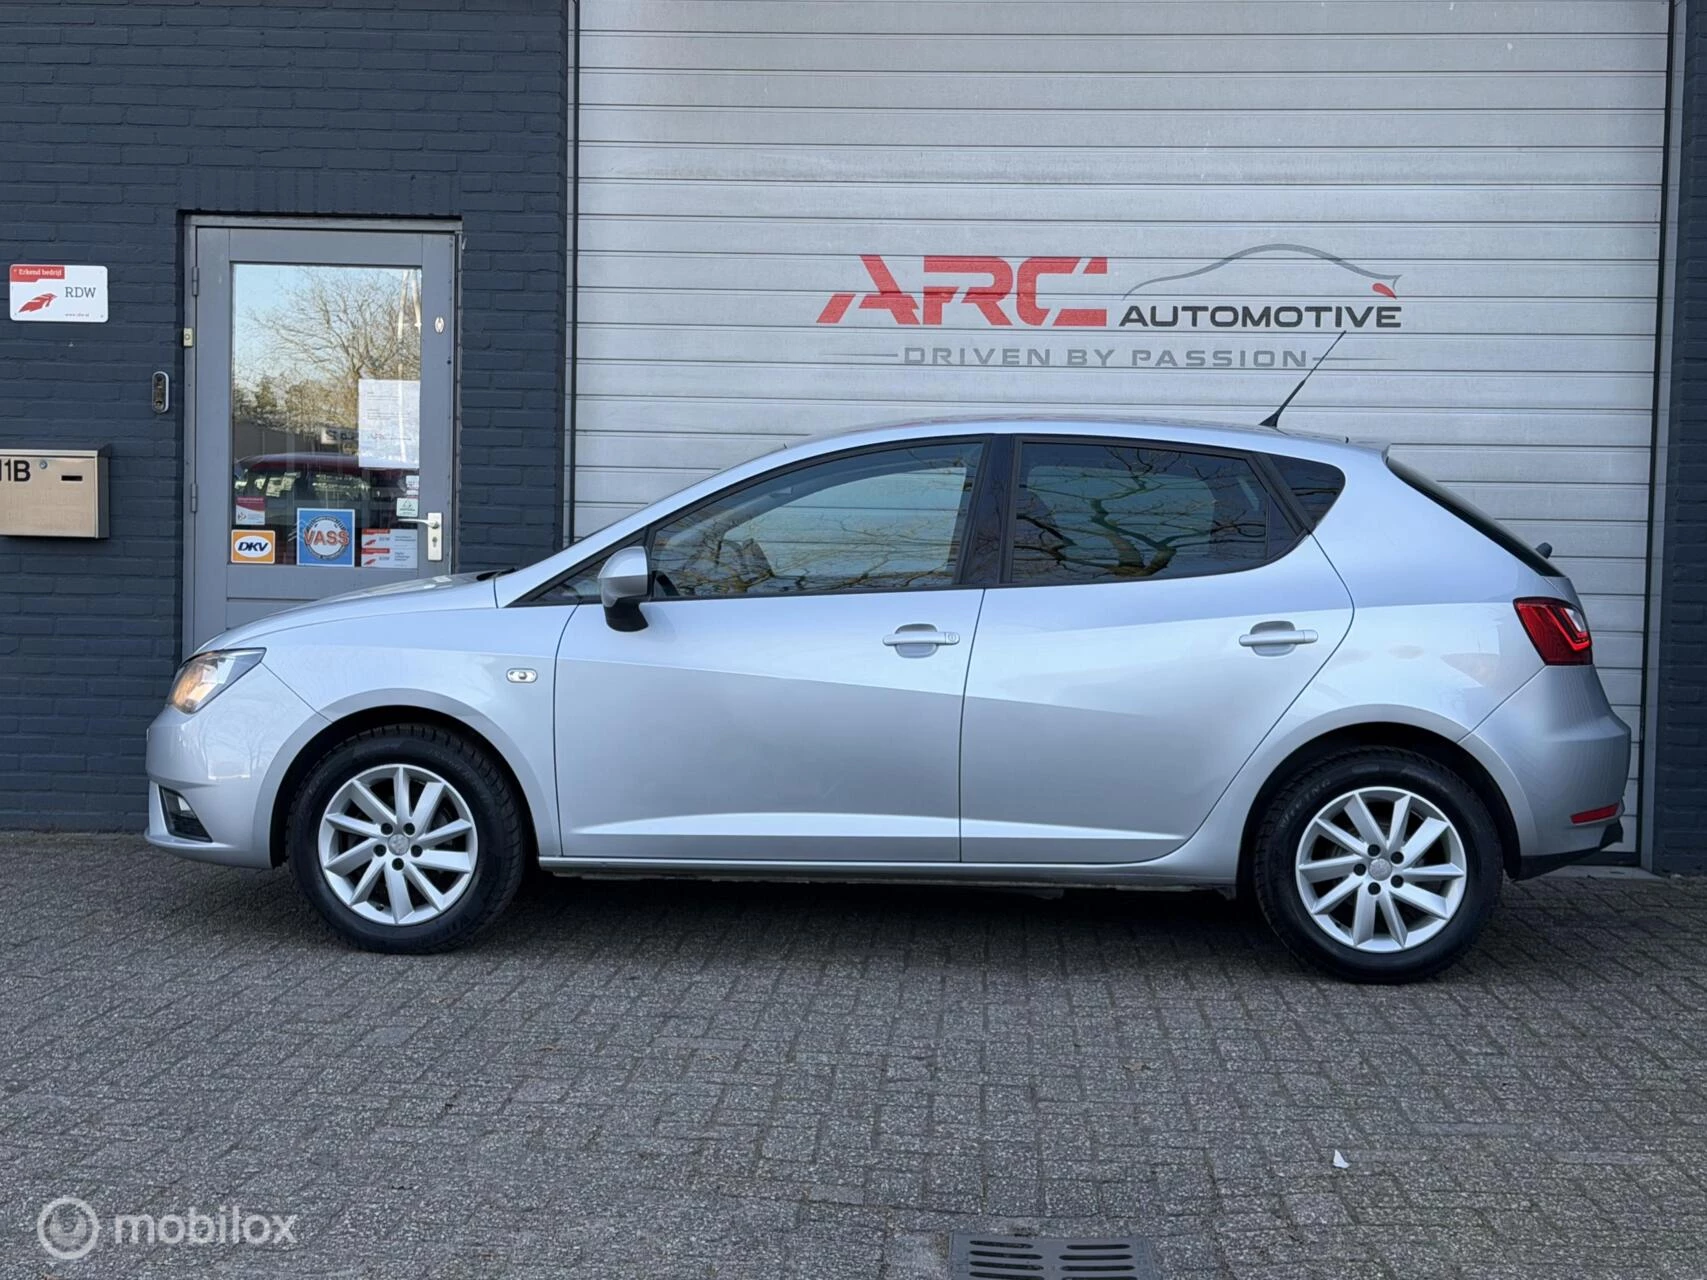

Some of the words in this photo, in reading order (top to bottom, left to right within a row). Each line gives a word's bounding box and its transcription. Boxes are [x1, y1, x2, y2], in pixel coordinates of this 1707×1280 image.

[65, 286, 97, 299] RDW
[816, 254, 1108, 327] ARC
[1119, 305, 1403, 329] AUTOMOTIVE
[904, 347, 1050, 366] DRIVEN
[1067, 349, 1115, 367] BY
[1131, 350, 1307, 368] PASSION
[237, 541, 269, 552] DKV
[304, 529, 350, 546] VASS
